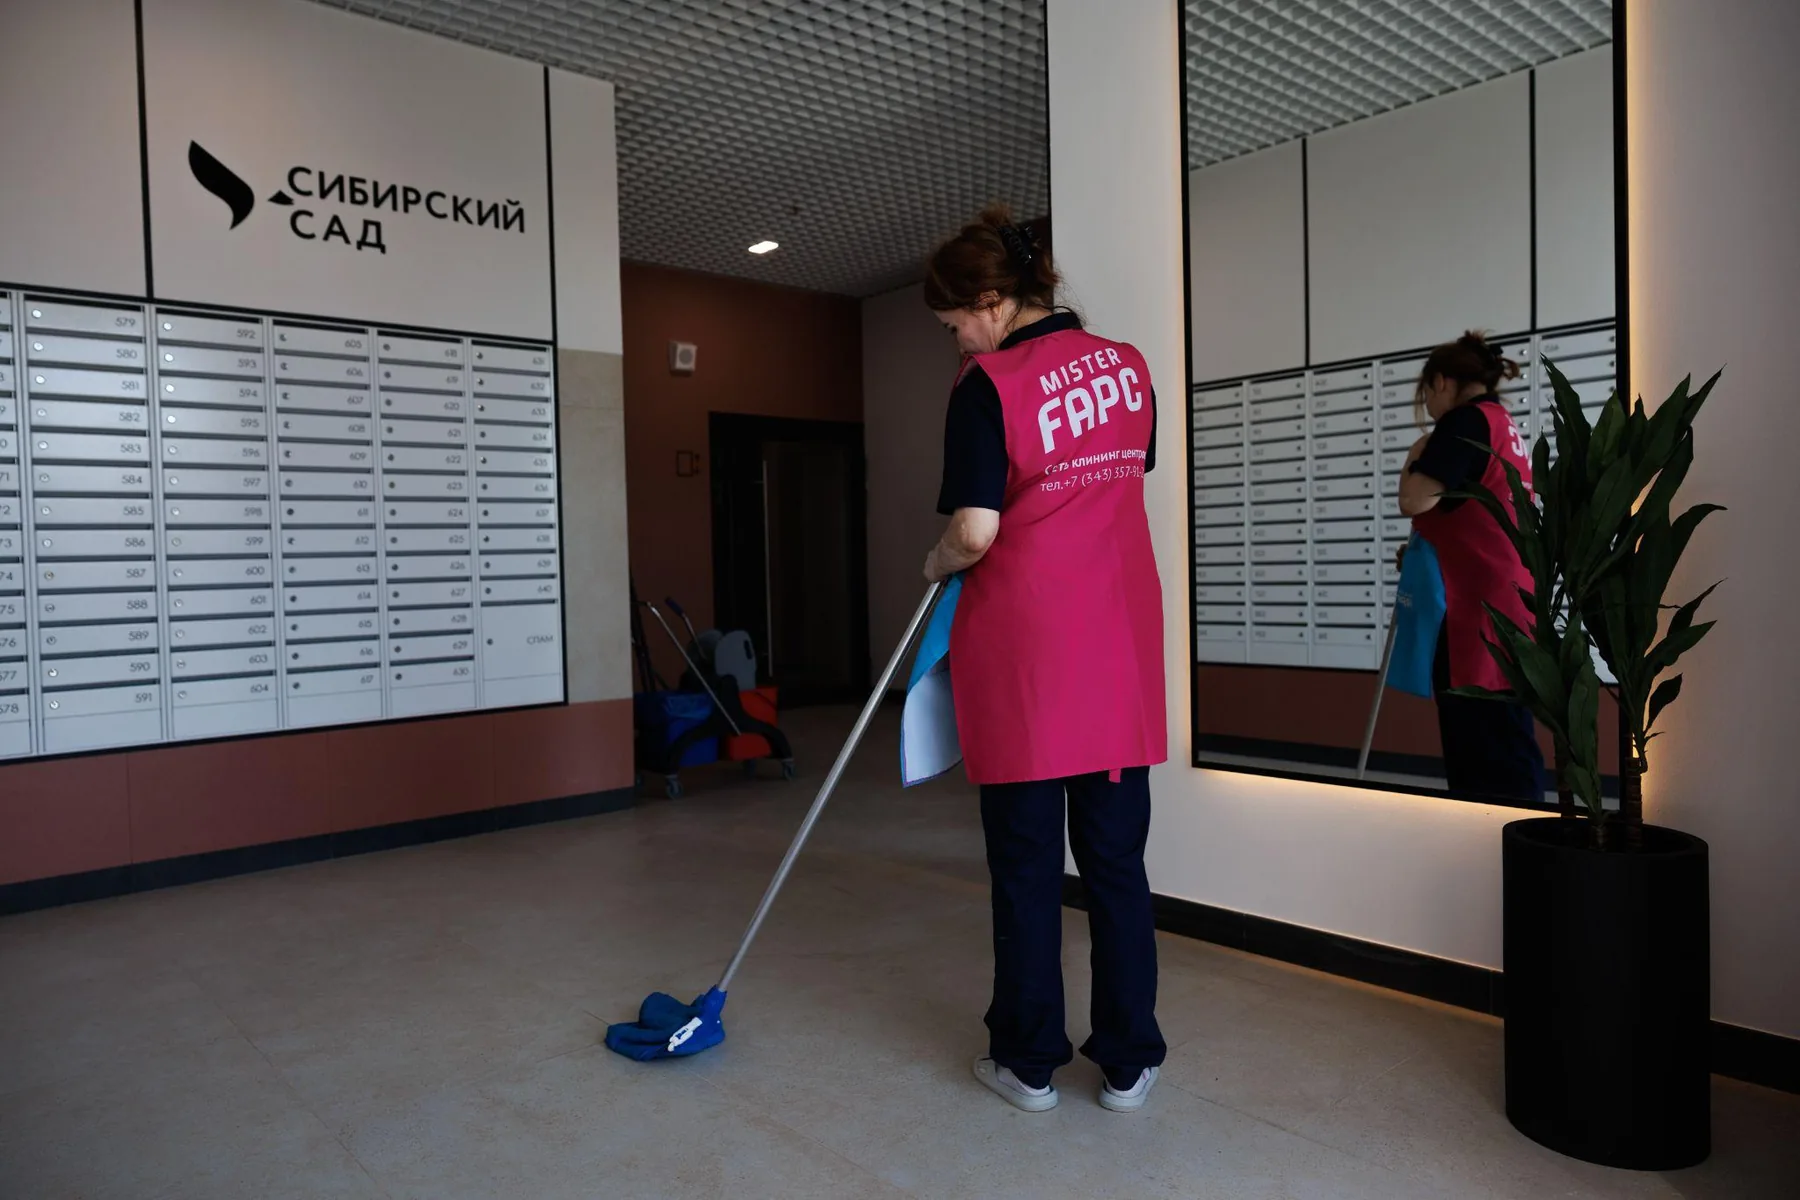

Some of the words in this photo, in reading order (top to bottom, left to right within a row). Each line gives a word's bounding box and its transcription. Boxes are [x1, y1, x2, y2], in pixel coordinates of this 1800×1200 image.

[287, 166, 525, 233] СИБИРСКИЙ
[289, 209, 387, 254] САД
[114, 316, 137, 328] 579
[236, 328, 256, 340] 592
[116, 348, 138, 360] 580
[237, 358, 258, 369] 593
[1039, 347, 1122, 396] MISTER
[121, 380, 140, 391] 581
[239, 388, 259, 398] 594
[119, 412, 141, 423] 582
[240, 417, 260, 429] 595
[120, 443, 142, 454] 583
[242, 447, 261, 458] 596
[1071, 450, 1120, 468] клининг
[1121, 449, 1146, 461] центро
[0, 471, 10, 482] 71
[121, 474, 143, 485] 584
[1081, 467, 1112, 488] (343)
[243, 477, 262, 488] 597
[0, 504, 11, 516] 72
[123, 506, 145, 516] 585
[0, 537, 13, 549] 73
[124, 537, 146, 548] 586
[245, 536, 264, 547] 599
[0, 571, 14, 581] 74
[126, 568, 147, 579] 587
[245, 565, 266, 576] 600
[126, 599, 149, 610] 588
[249, 594, 267, 605] 601
[0, 604, 16, 615] 75
[247, 624, 267, 636] 602
[128, 630, 150, 642] 589
[526, 635, 554, 646] СПАМ
[248, 653, 269, 664] 603
[129, 661, 151, 673] 590
[250, 683, 269, 694] 604
[135, 692, 153, 704] 591
